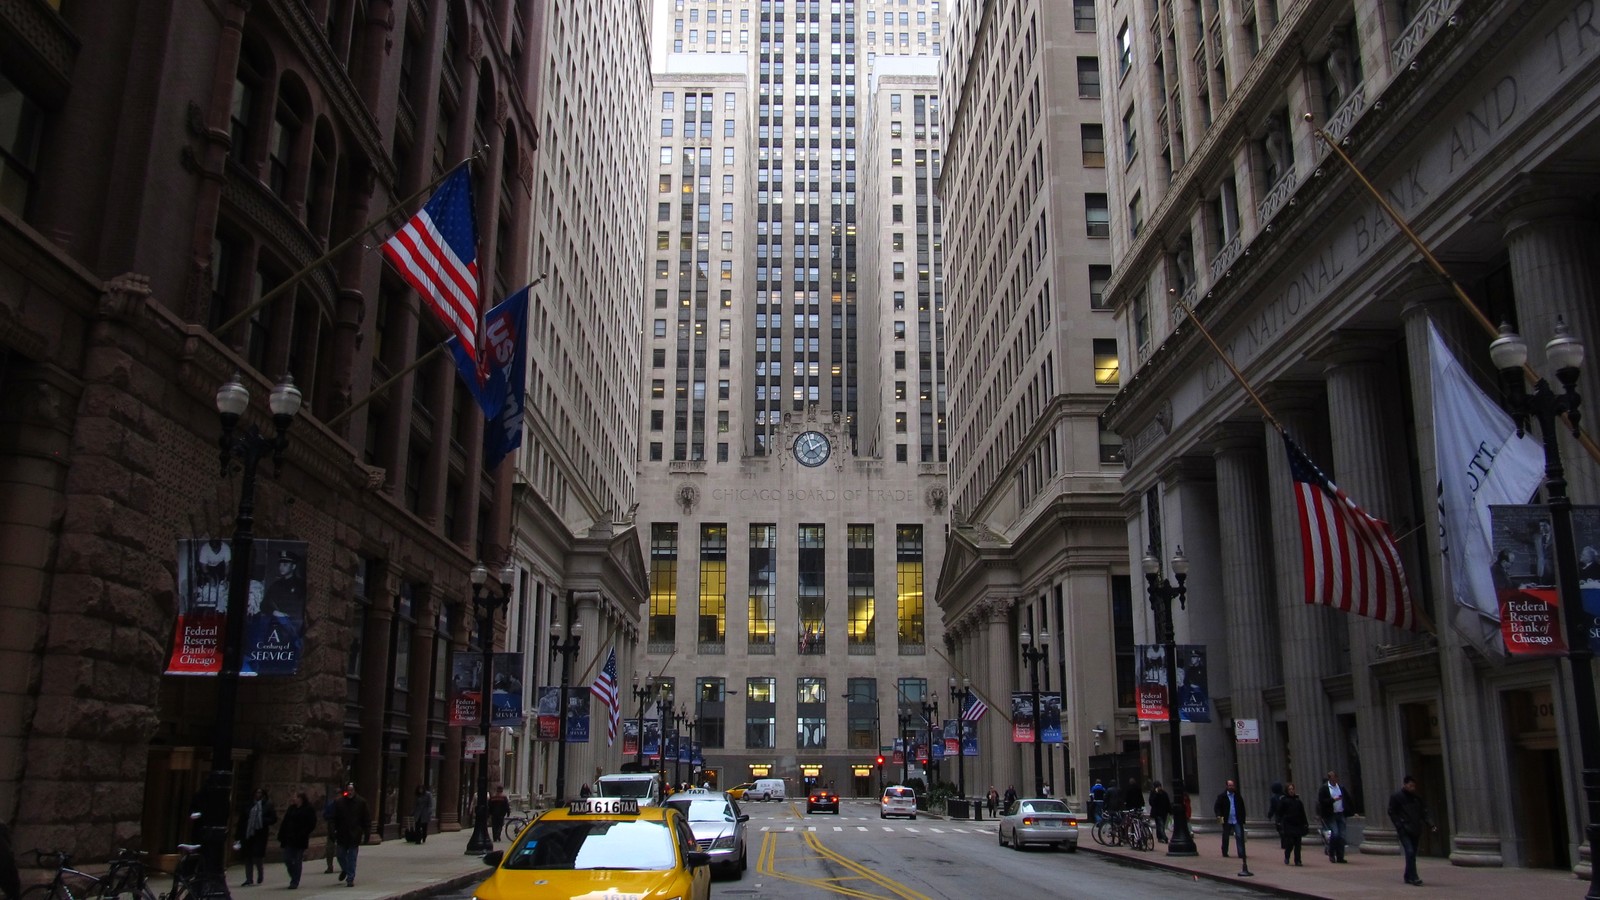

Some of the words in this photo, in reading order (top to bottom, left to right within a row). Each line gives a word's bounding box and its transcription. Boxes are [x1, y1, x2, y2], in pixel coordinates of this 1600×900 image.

[1247, 246, 1344, 354] NATIONAL
[1353, 158, 1429, 257] BANK
[1449, 75, 1518, 174] AND
[712, 488, 781, 501] CHICAGO
[787, 488, 836, 501] BOARD
[843, 488, 862, 501] OF
[869, 488, 914, 501] TRADE
[1508, 601, 1548, 612] Federal
[1510, 612, 1549, 622] Reserve
[185, 626, 217, 636] Federal
[1510, 622, 1539, 633] Bank
[1540, 622, 1550, 635] of
[184, 636, 217, 645] Reserve
[267, 629, 280, 643] A
[1511, 634, 1553, 645] Chicago
[182, 646, 206, 655] Bank
[206, 646, 216, 656] of
[256, 642, 283, 650] Century
[179, 655, 216, 667] Chicago
[250, 651, 294, 661] SERVICE
[1189, 694, 1197, 702] A
[504, 700, 511, 708] A
[570, 802, 587, 812] TAXI
[586, 801, 620, 813] 1616
[620, 801, 637, 812] TAXI
